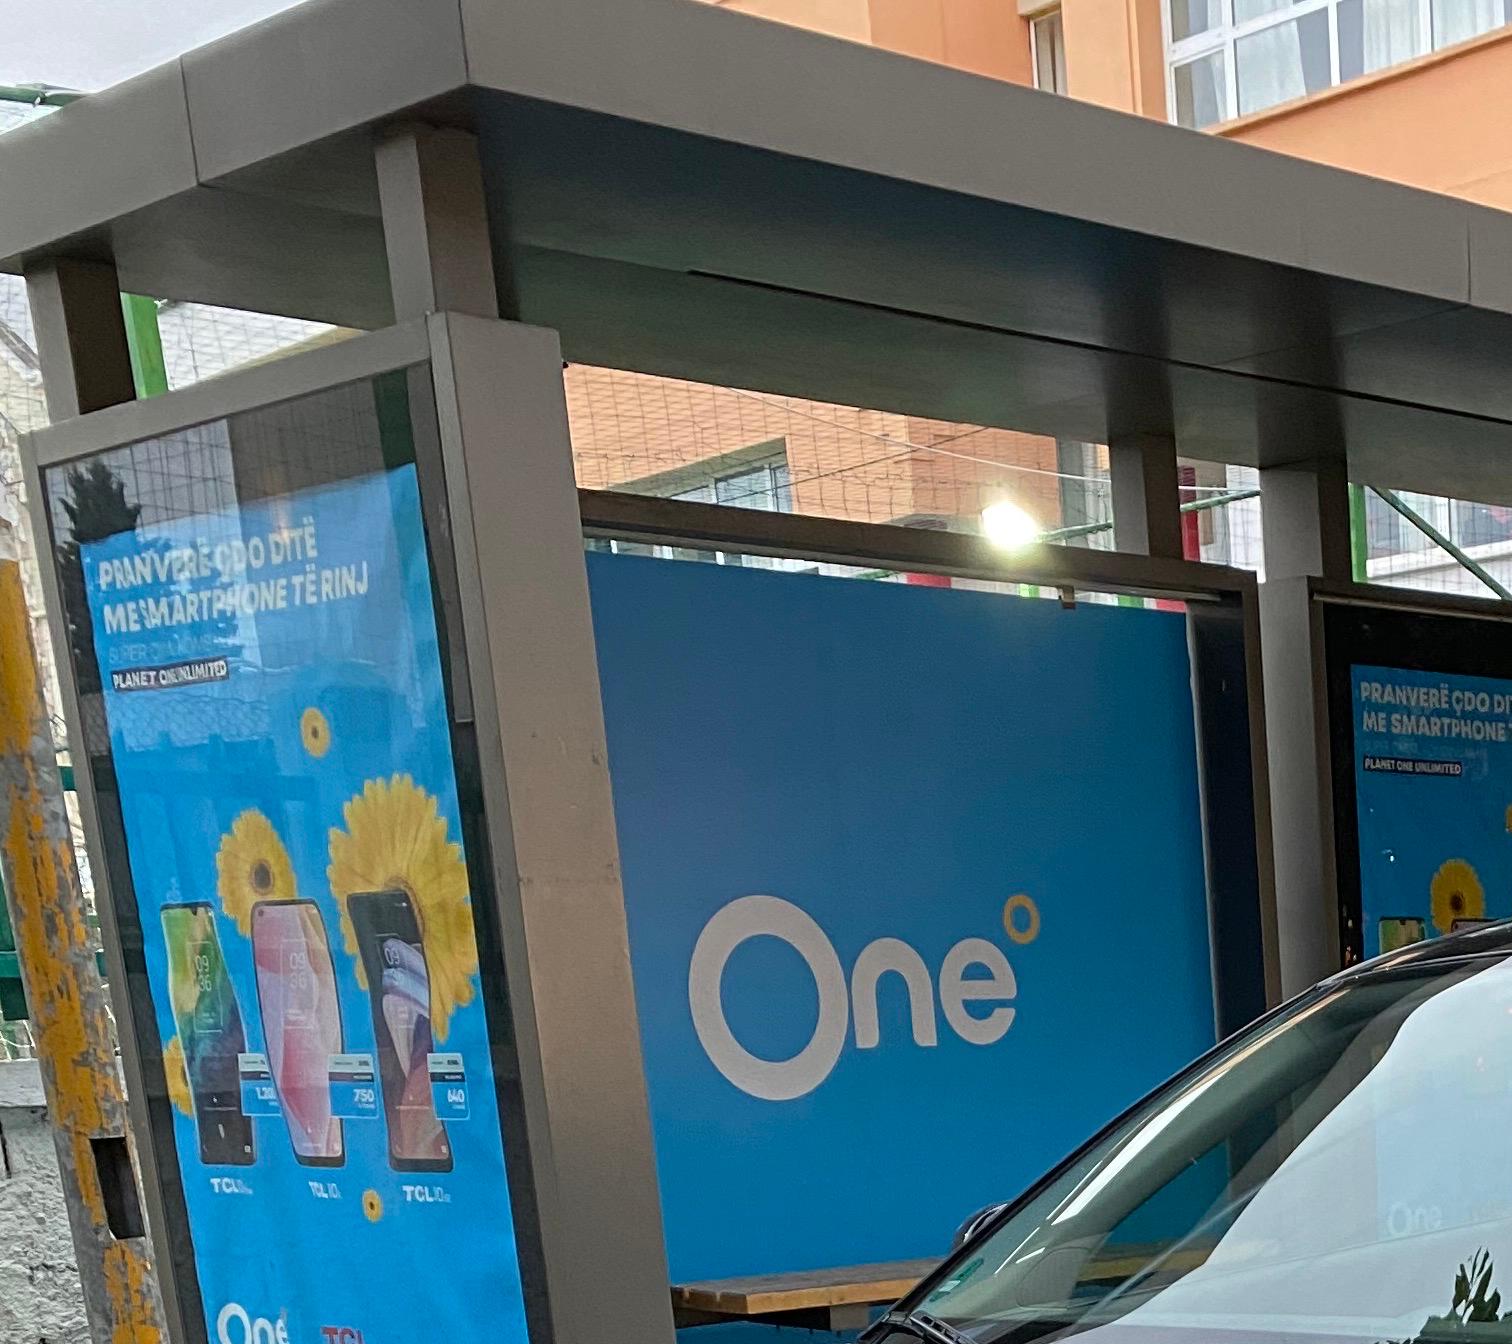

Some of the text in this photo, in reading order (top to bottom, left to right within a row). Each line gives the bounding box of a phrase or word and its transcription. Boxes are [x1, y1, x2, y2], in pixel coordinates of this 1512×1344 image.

[268, 515, 318, 566] DITË
[103, 560, 369, 635] ME SMARTPHONE TË RINJ
[112, 671, 157, 689] PLANET
[1360, 681, 1449, 710] PRANVERË
[1451, 690, 1490, 716] ÇDO
[1362, 711, 1387, 733] ME
[1390, 713, 1506, 742] SMARTPHONE
[1364, 758, 1462, 775] PLANET ONE UNLIMITED
[688, 895, 1018, 1101] One
[402, 1184, 434, 1202] TCL
